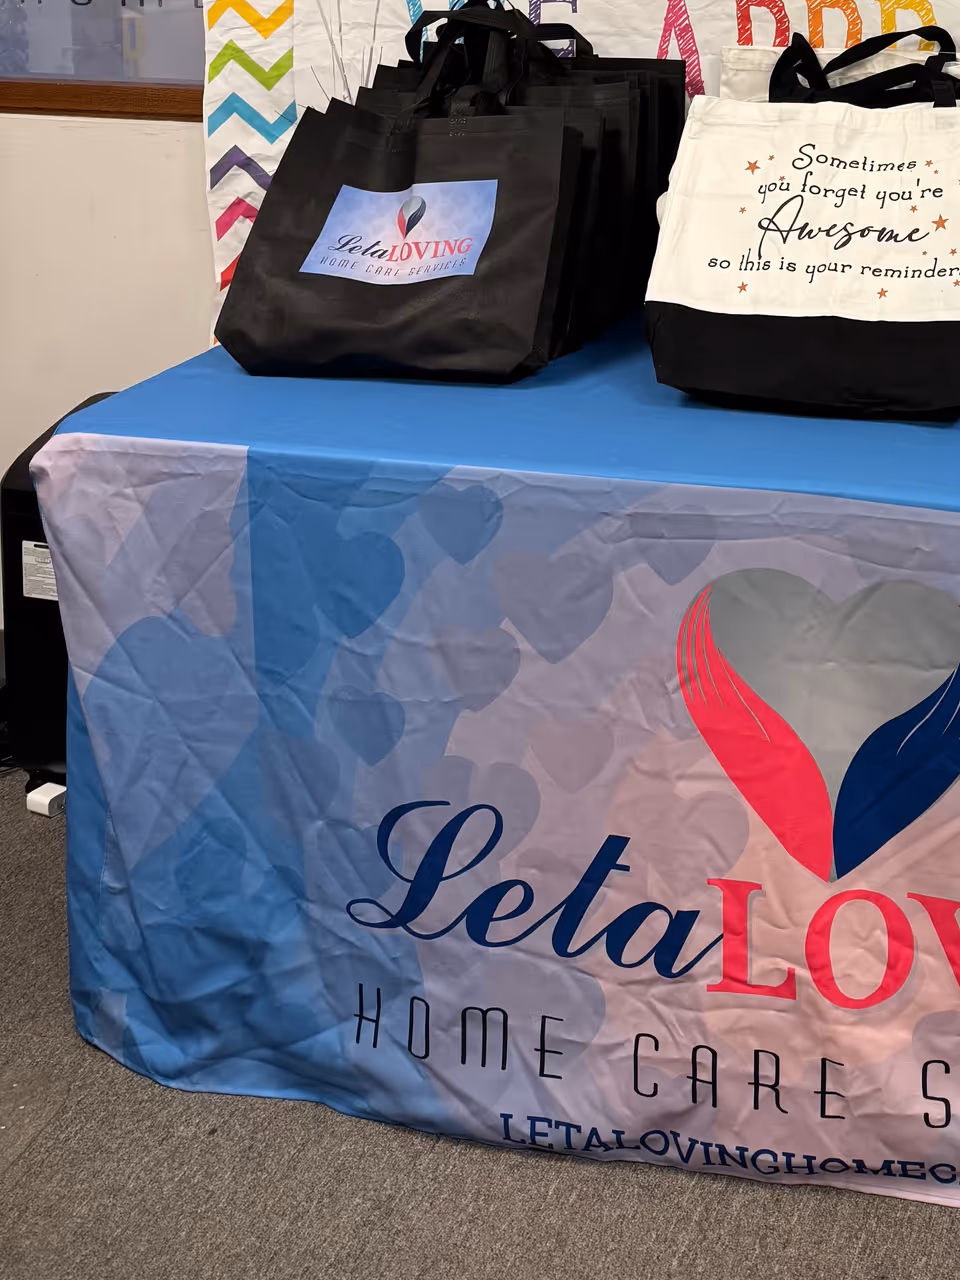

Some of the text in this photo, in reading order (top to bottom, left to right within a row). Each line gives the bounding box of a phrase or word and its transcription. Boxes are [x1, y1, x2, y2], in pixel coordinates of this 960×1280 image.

[792, 143, 917, 172] Sometimes
[758, 171, 944, 209] you forget you're
[757, 194, 930, 260] Awesome
[319, 256, 467, 277] HOME CARE SERVICES
[707, 257, 731, 270] so
[739, 248, 771, 271] this
[779, 257, 797, 272] is
[805, 262, 852, 283] your
[354, 983, 563, 1080] HOME
[633, 1032, 845, 1120] CARE
